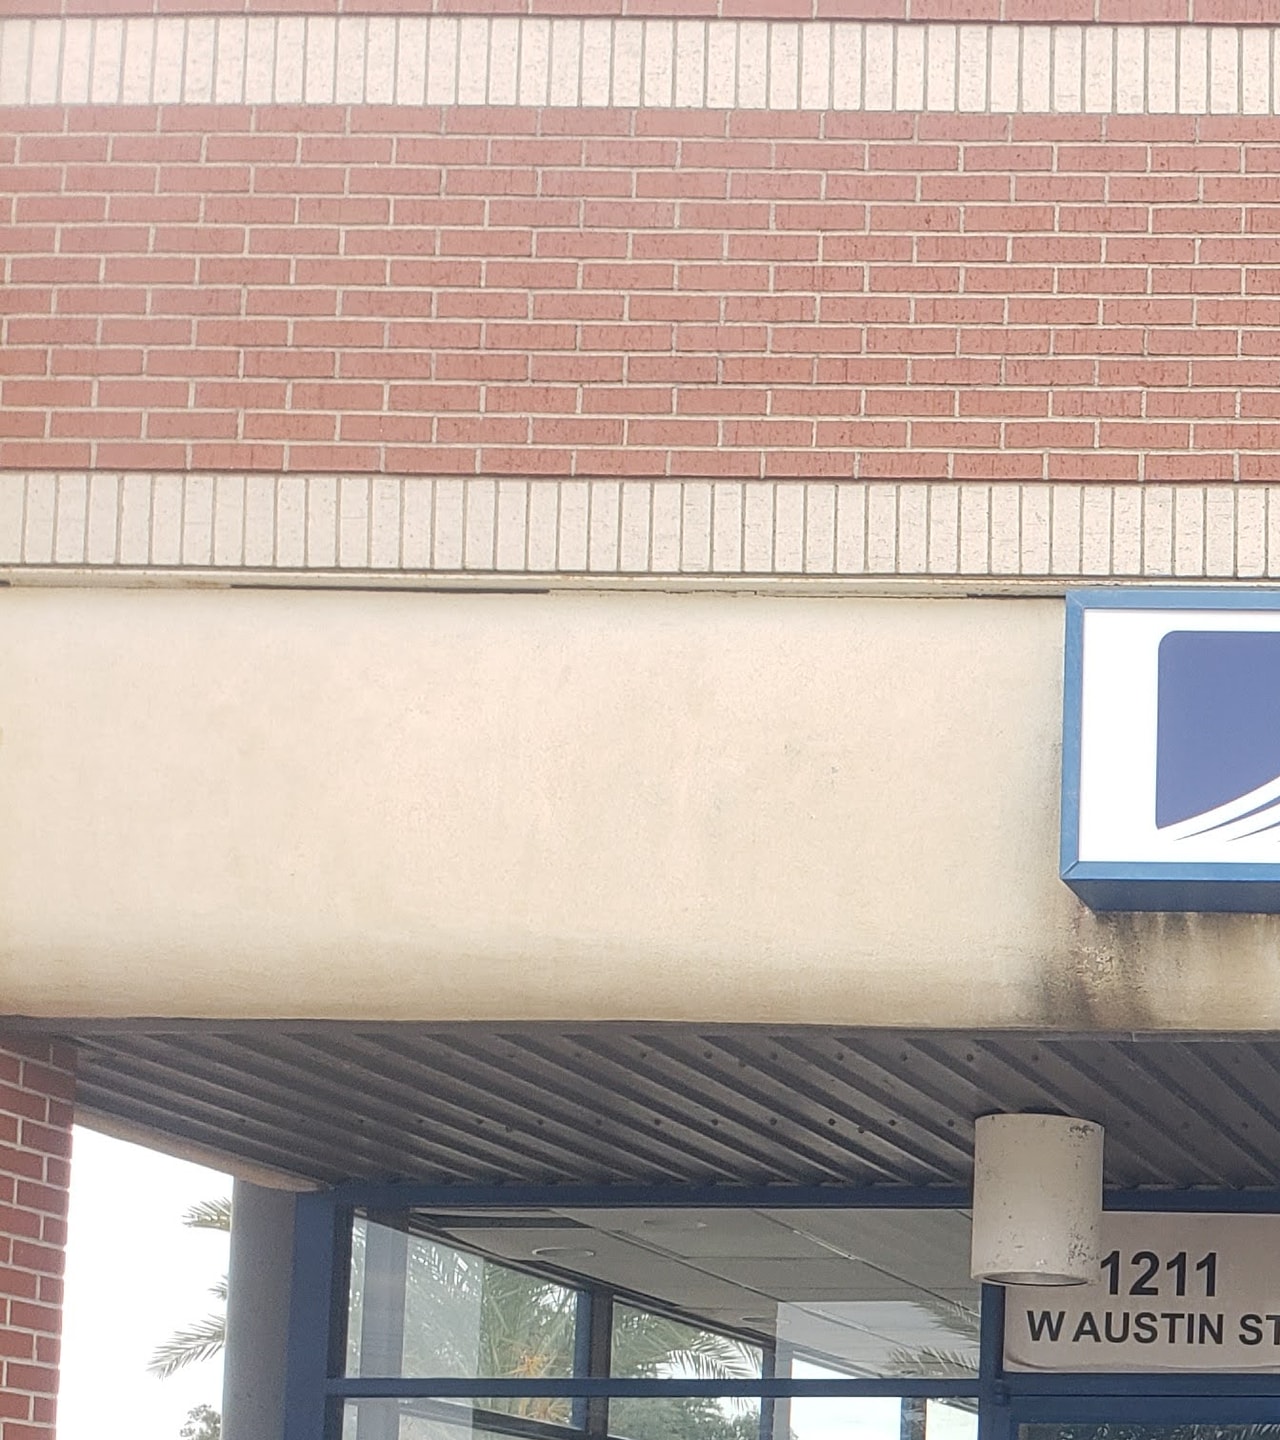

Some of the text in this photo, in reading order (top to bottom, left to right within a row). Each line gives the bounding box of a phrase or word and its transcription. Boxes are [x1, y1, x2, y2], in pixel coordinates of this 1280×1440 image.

[1100, 1249, 1217, 1298] 1211
[1026, 1309, 1066, 1342] W
[1071, 1311, 1225, 1345] AUSTIN
